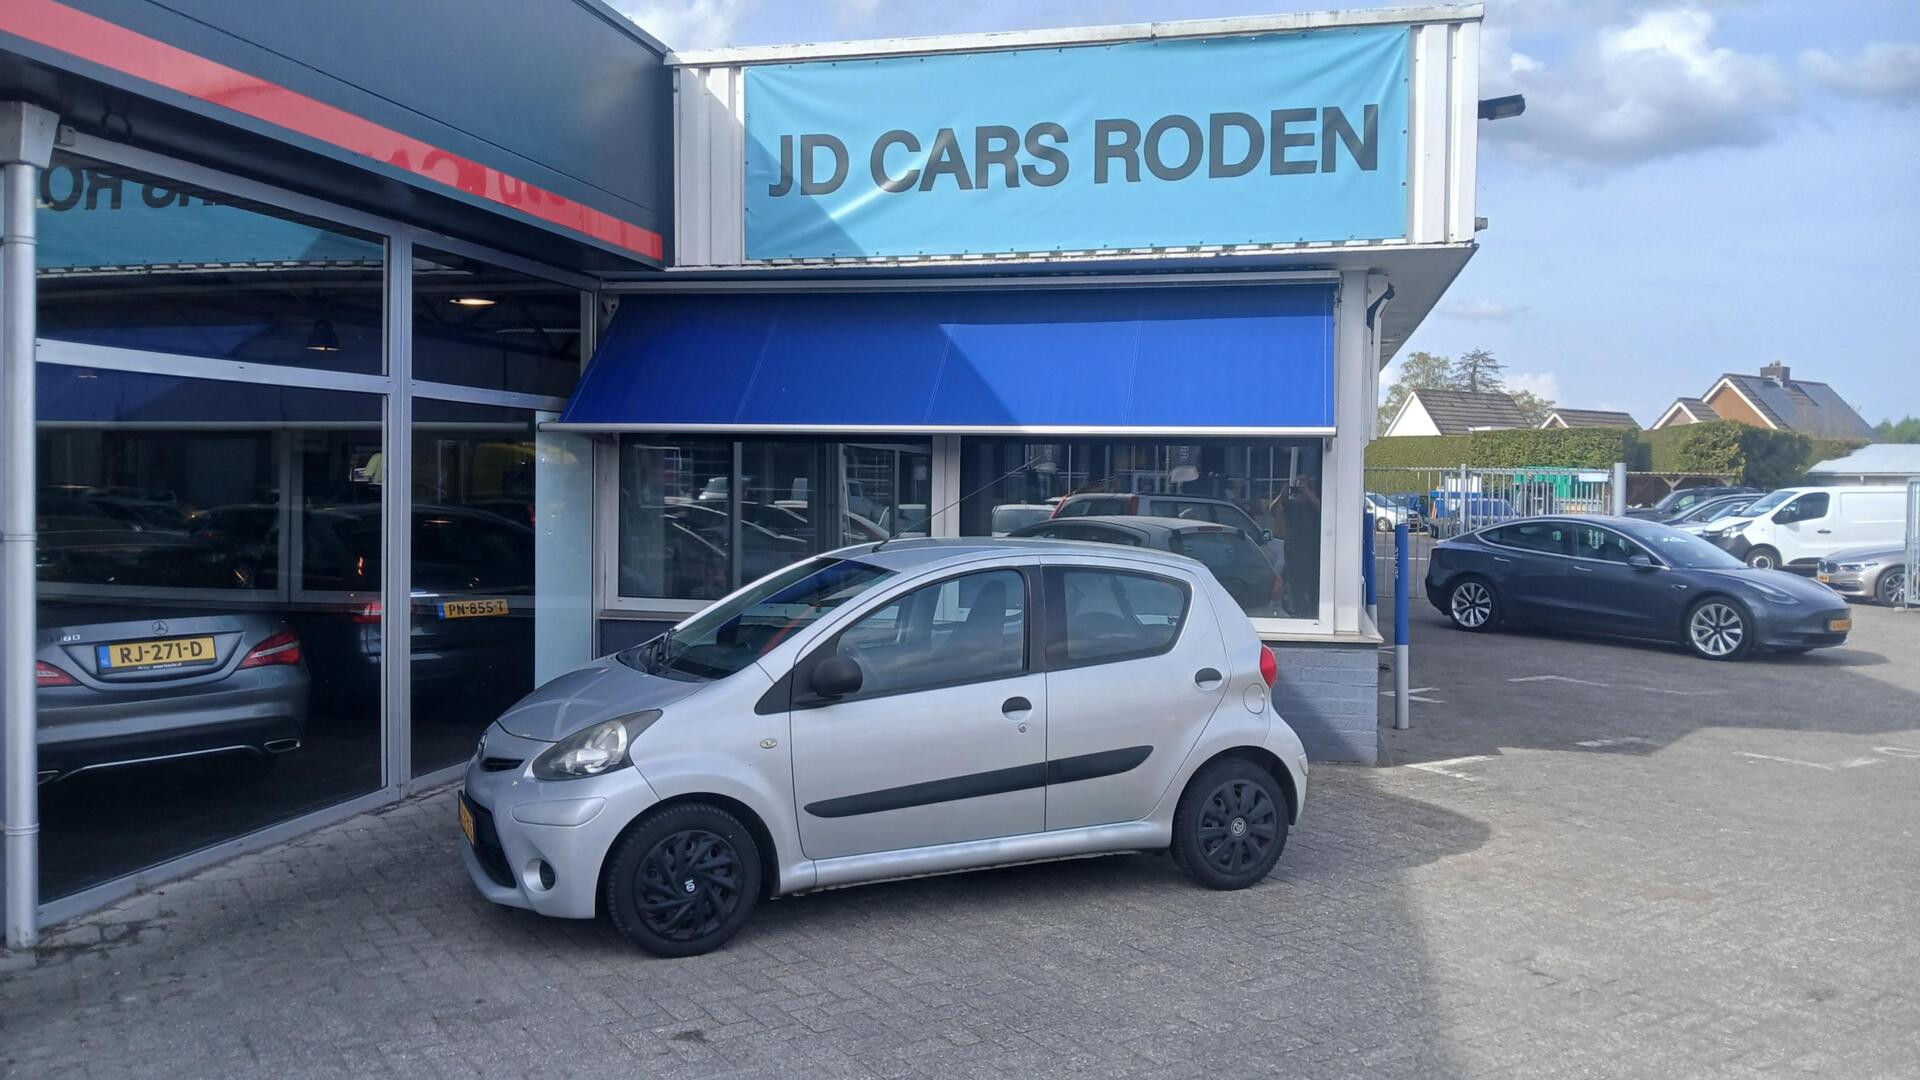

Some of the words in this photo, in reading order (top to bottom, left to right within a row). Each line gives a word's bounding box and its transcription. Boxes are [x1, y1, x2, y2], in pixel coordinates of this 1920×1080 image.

[769, 133, 850, 197] JD
[870, 122, 1070, 193] CARS
[1094, 103, 1379, 184] RODEN
[448, 601, 505, 616] PN-855-T
[119, 641, 204, 664] RJ-271-D
